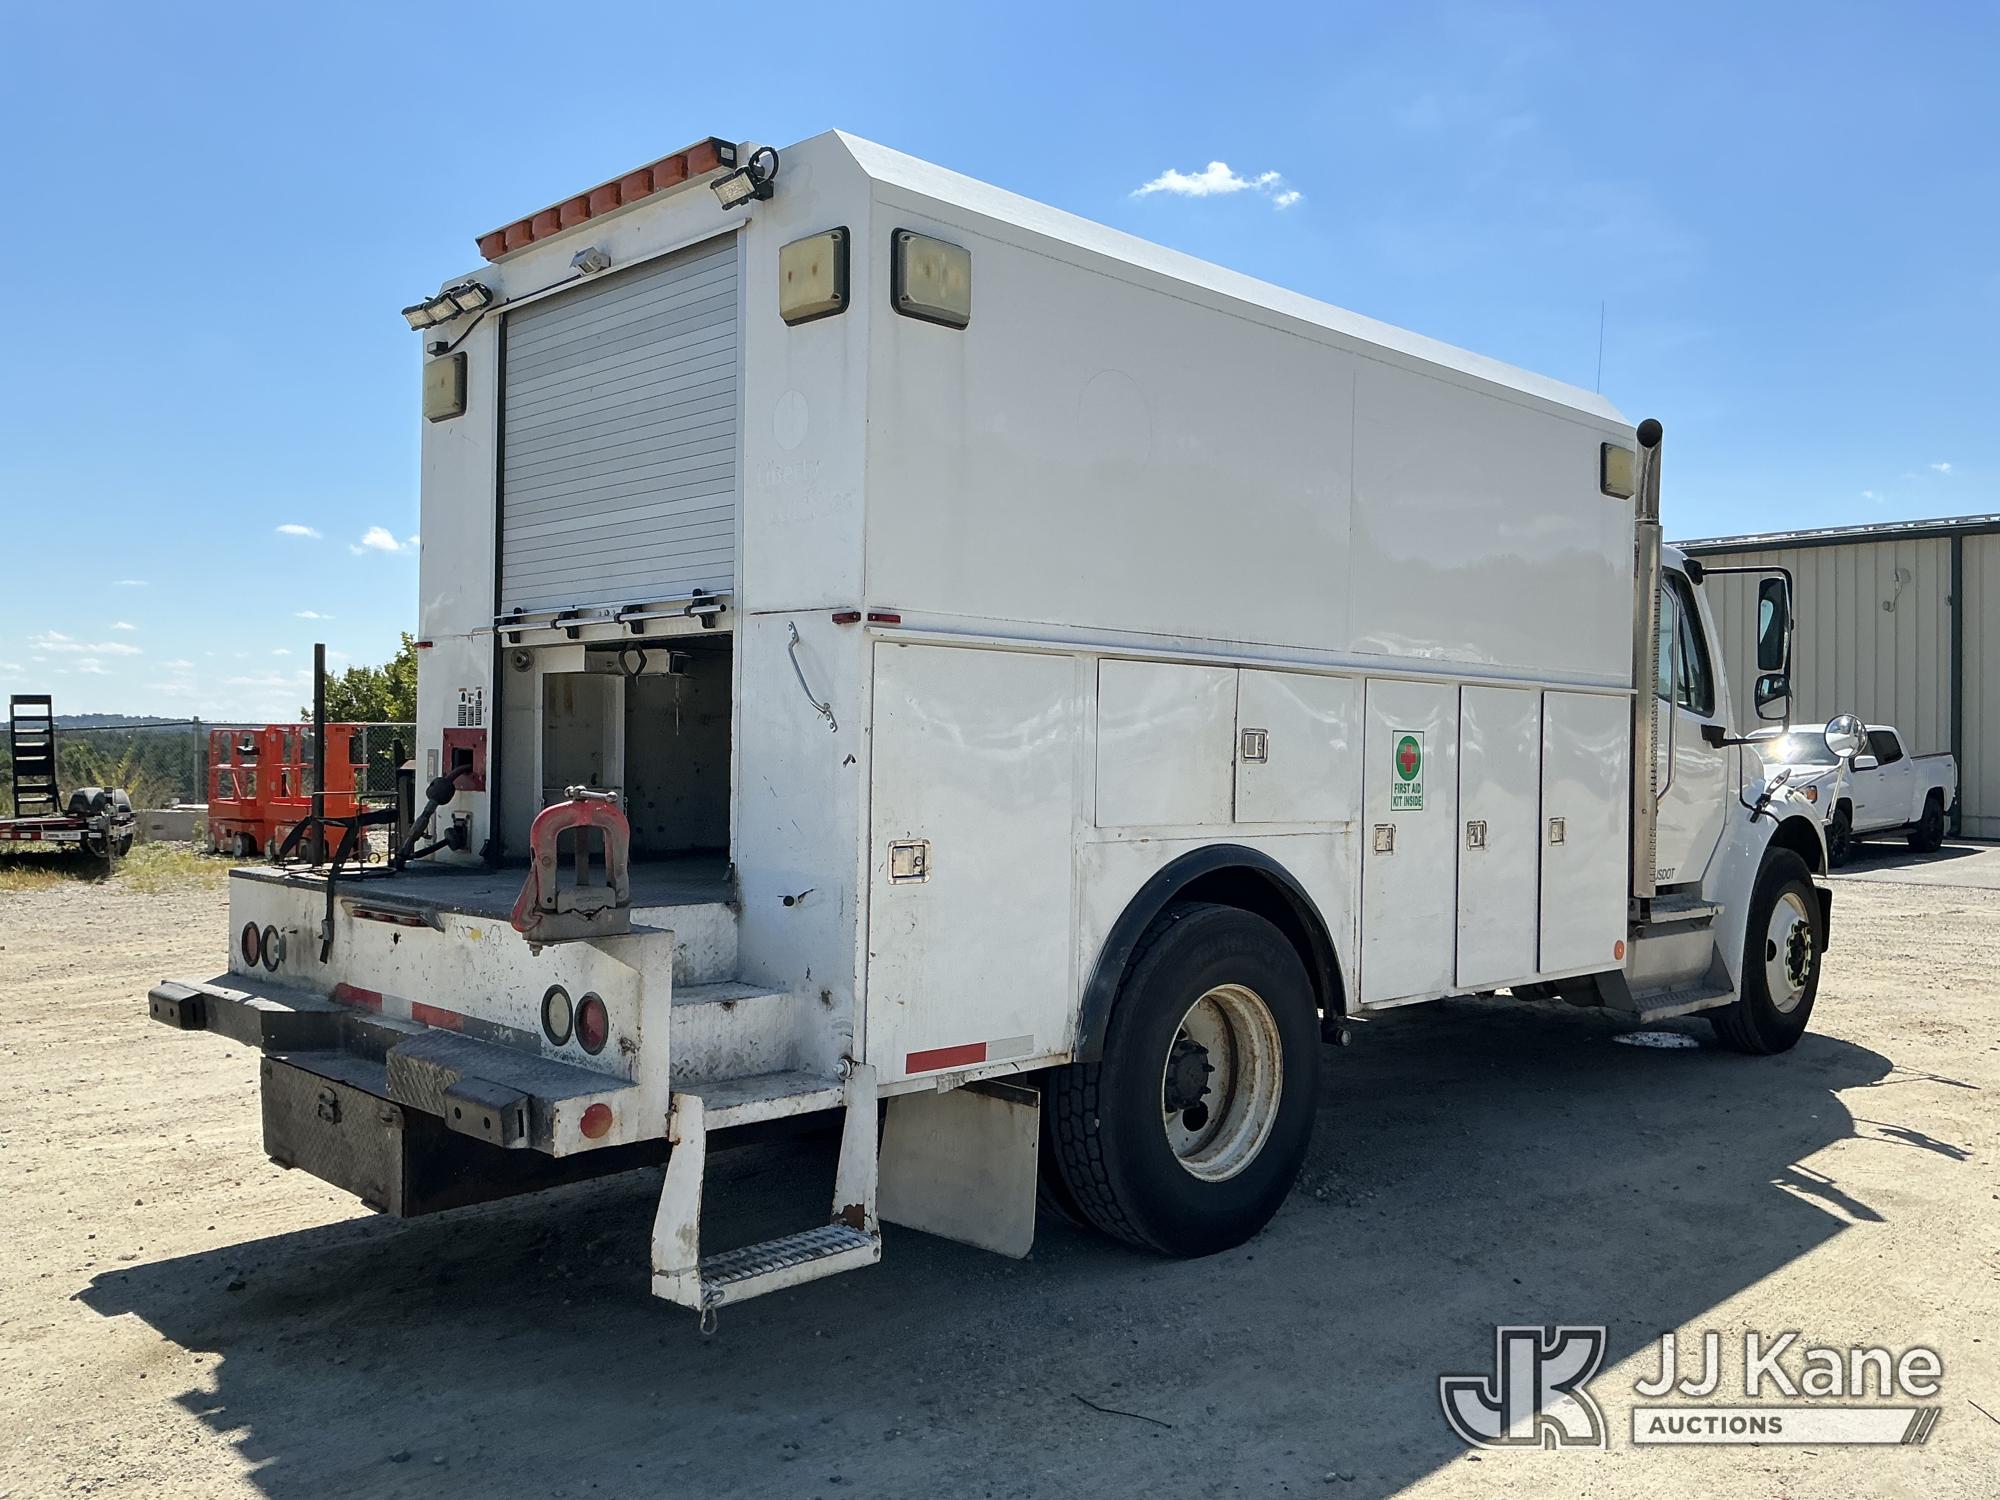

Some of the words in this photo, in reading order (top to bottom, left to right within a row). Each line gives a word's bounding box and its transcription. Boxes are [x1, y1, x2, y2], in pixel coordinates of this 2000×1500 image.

[1394, 783, 1410, 794] FIRST
[1411, 783, 1421, 794] AID
[1393, 796, 1402, 806] KIT
[1404, 796, 1421, 806] INSIDE
